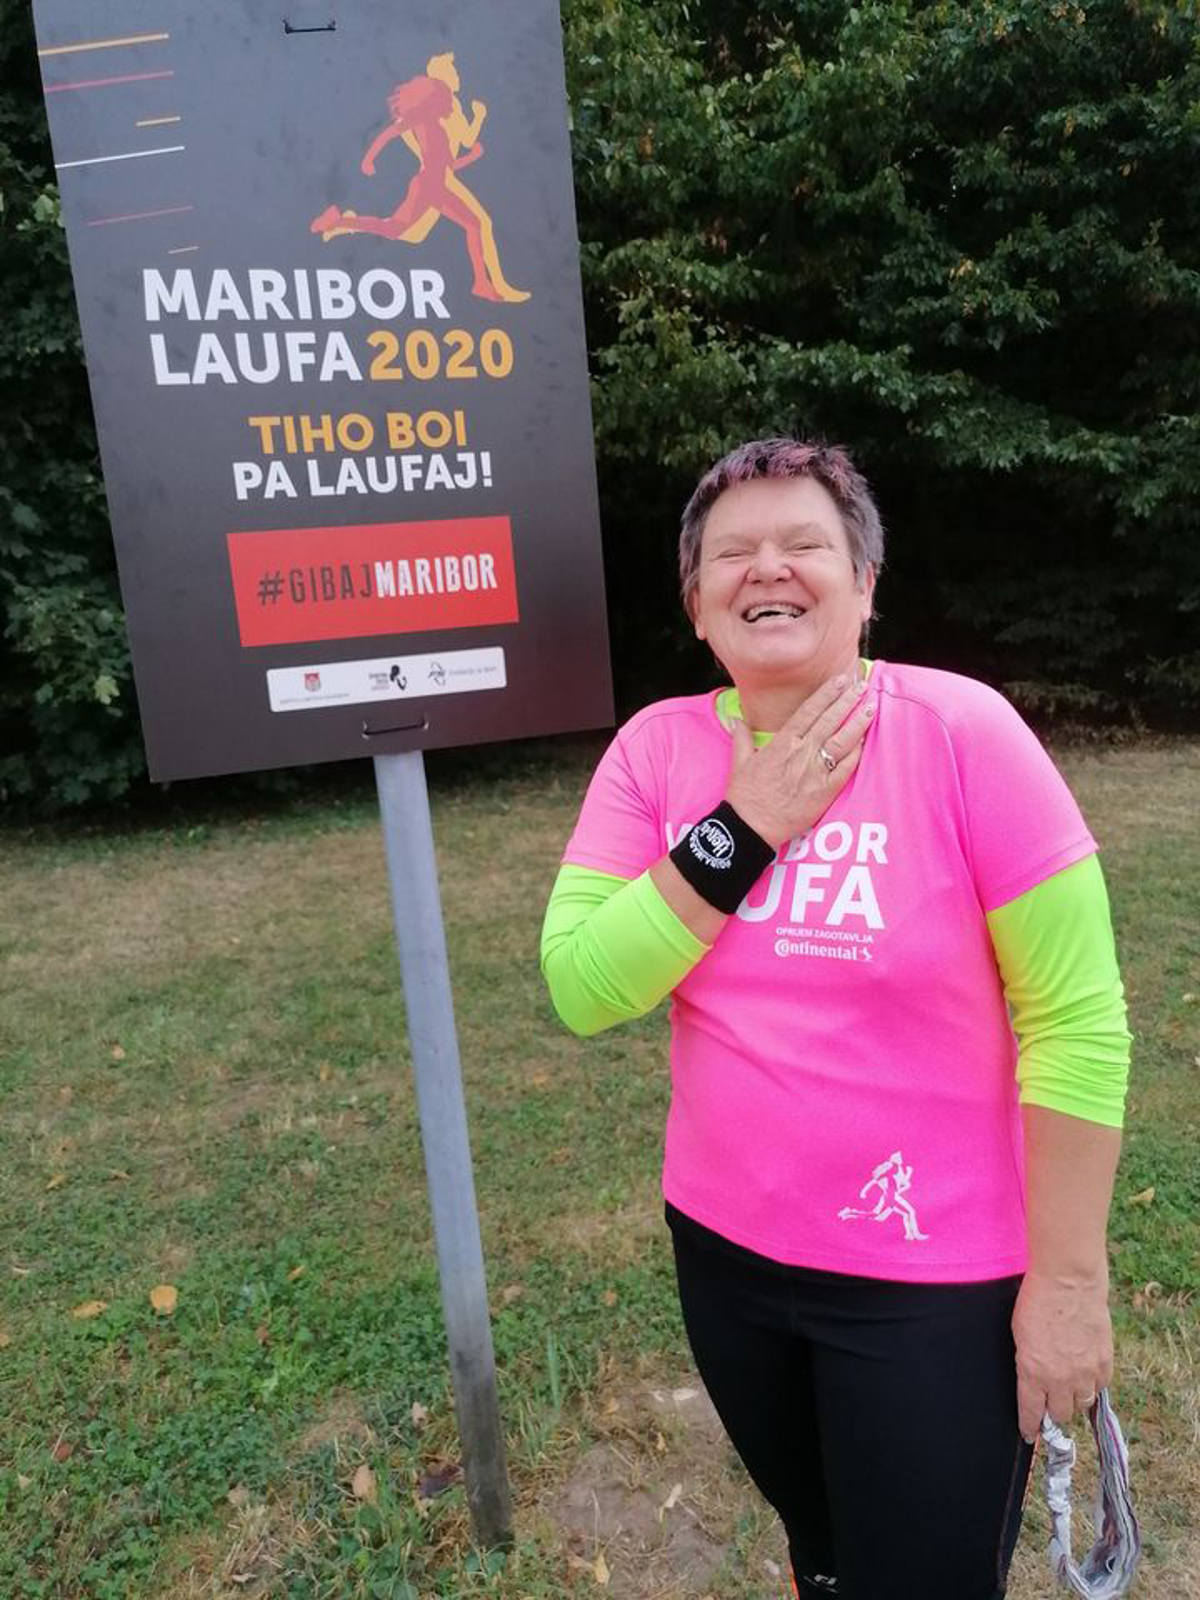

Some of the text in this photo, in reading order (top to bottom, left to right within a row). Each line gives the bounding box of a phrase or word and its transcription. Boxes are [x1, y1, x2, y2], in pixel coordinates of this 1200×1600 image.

[142, 267, 451, 322] MARIBOR
[149, 328, 514, 386] LAUFA 2020
[248, 409, 467, 455] TIHO BOI
[232, 451, 493, 500] PA LAUFAJ!
[736, 863, 886, 930] UFA
